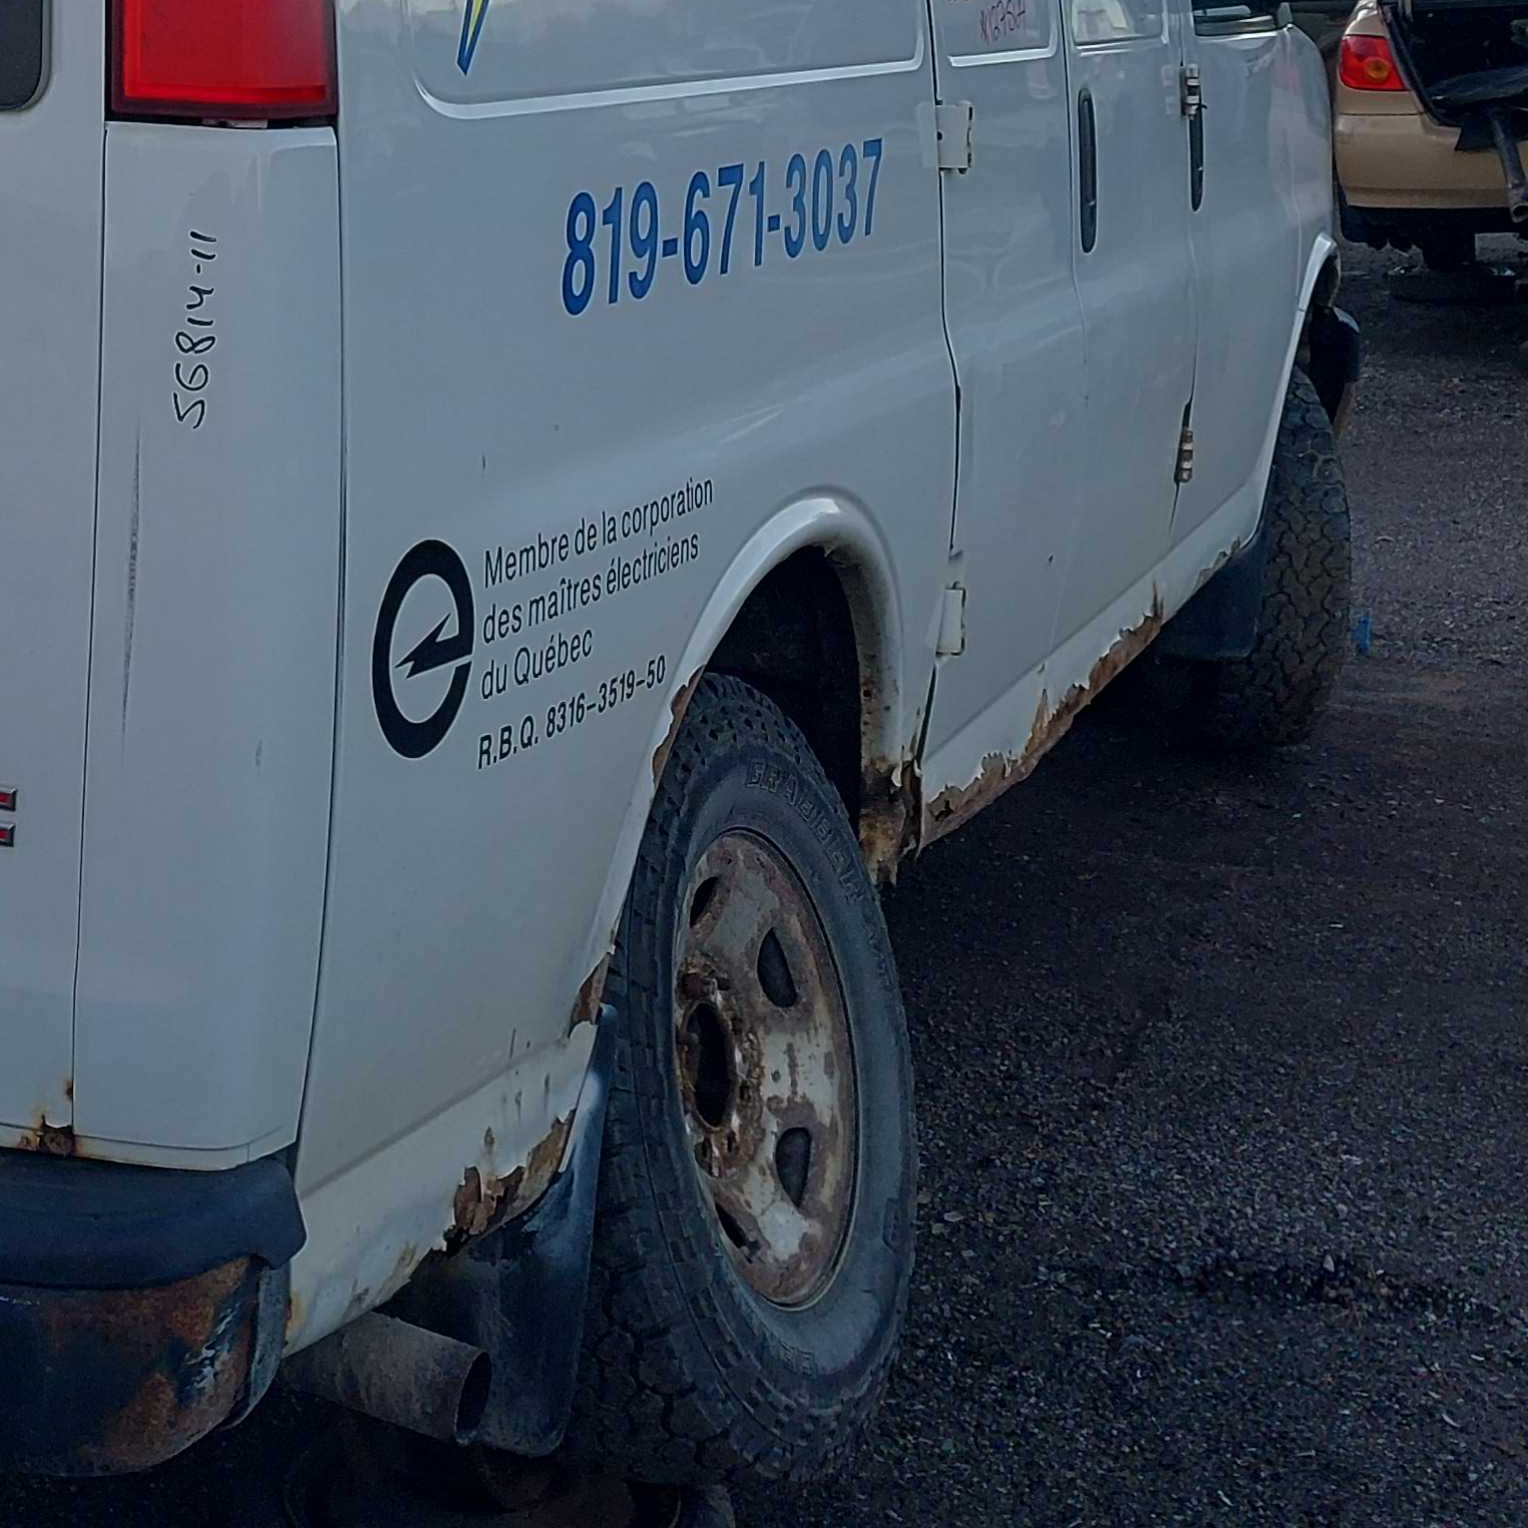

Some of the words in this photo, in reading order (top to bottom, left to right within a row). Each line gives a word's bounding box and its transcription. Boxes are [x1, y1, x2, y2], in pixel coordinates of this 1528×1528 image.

[561, 137, 883, 316] 819-671-3037
[483, 603, 523, 644] des
[528, 573, 602, 627] maîtres
[606, 532, 699, 595] électriciens
[484, 532, 570, 589] Membre
[574, 517, 598, 556] de
[602, 510, 618, 547] la
[621, 476, 714, 537] corporation
[477, 714, 540, 770] R.B.Q.
[545, 654, 667, 735] 8316-3519-50
[480, 659, 509, 701] du
[514, 628, 593, 689] Québec
